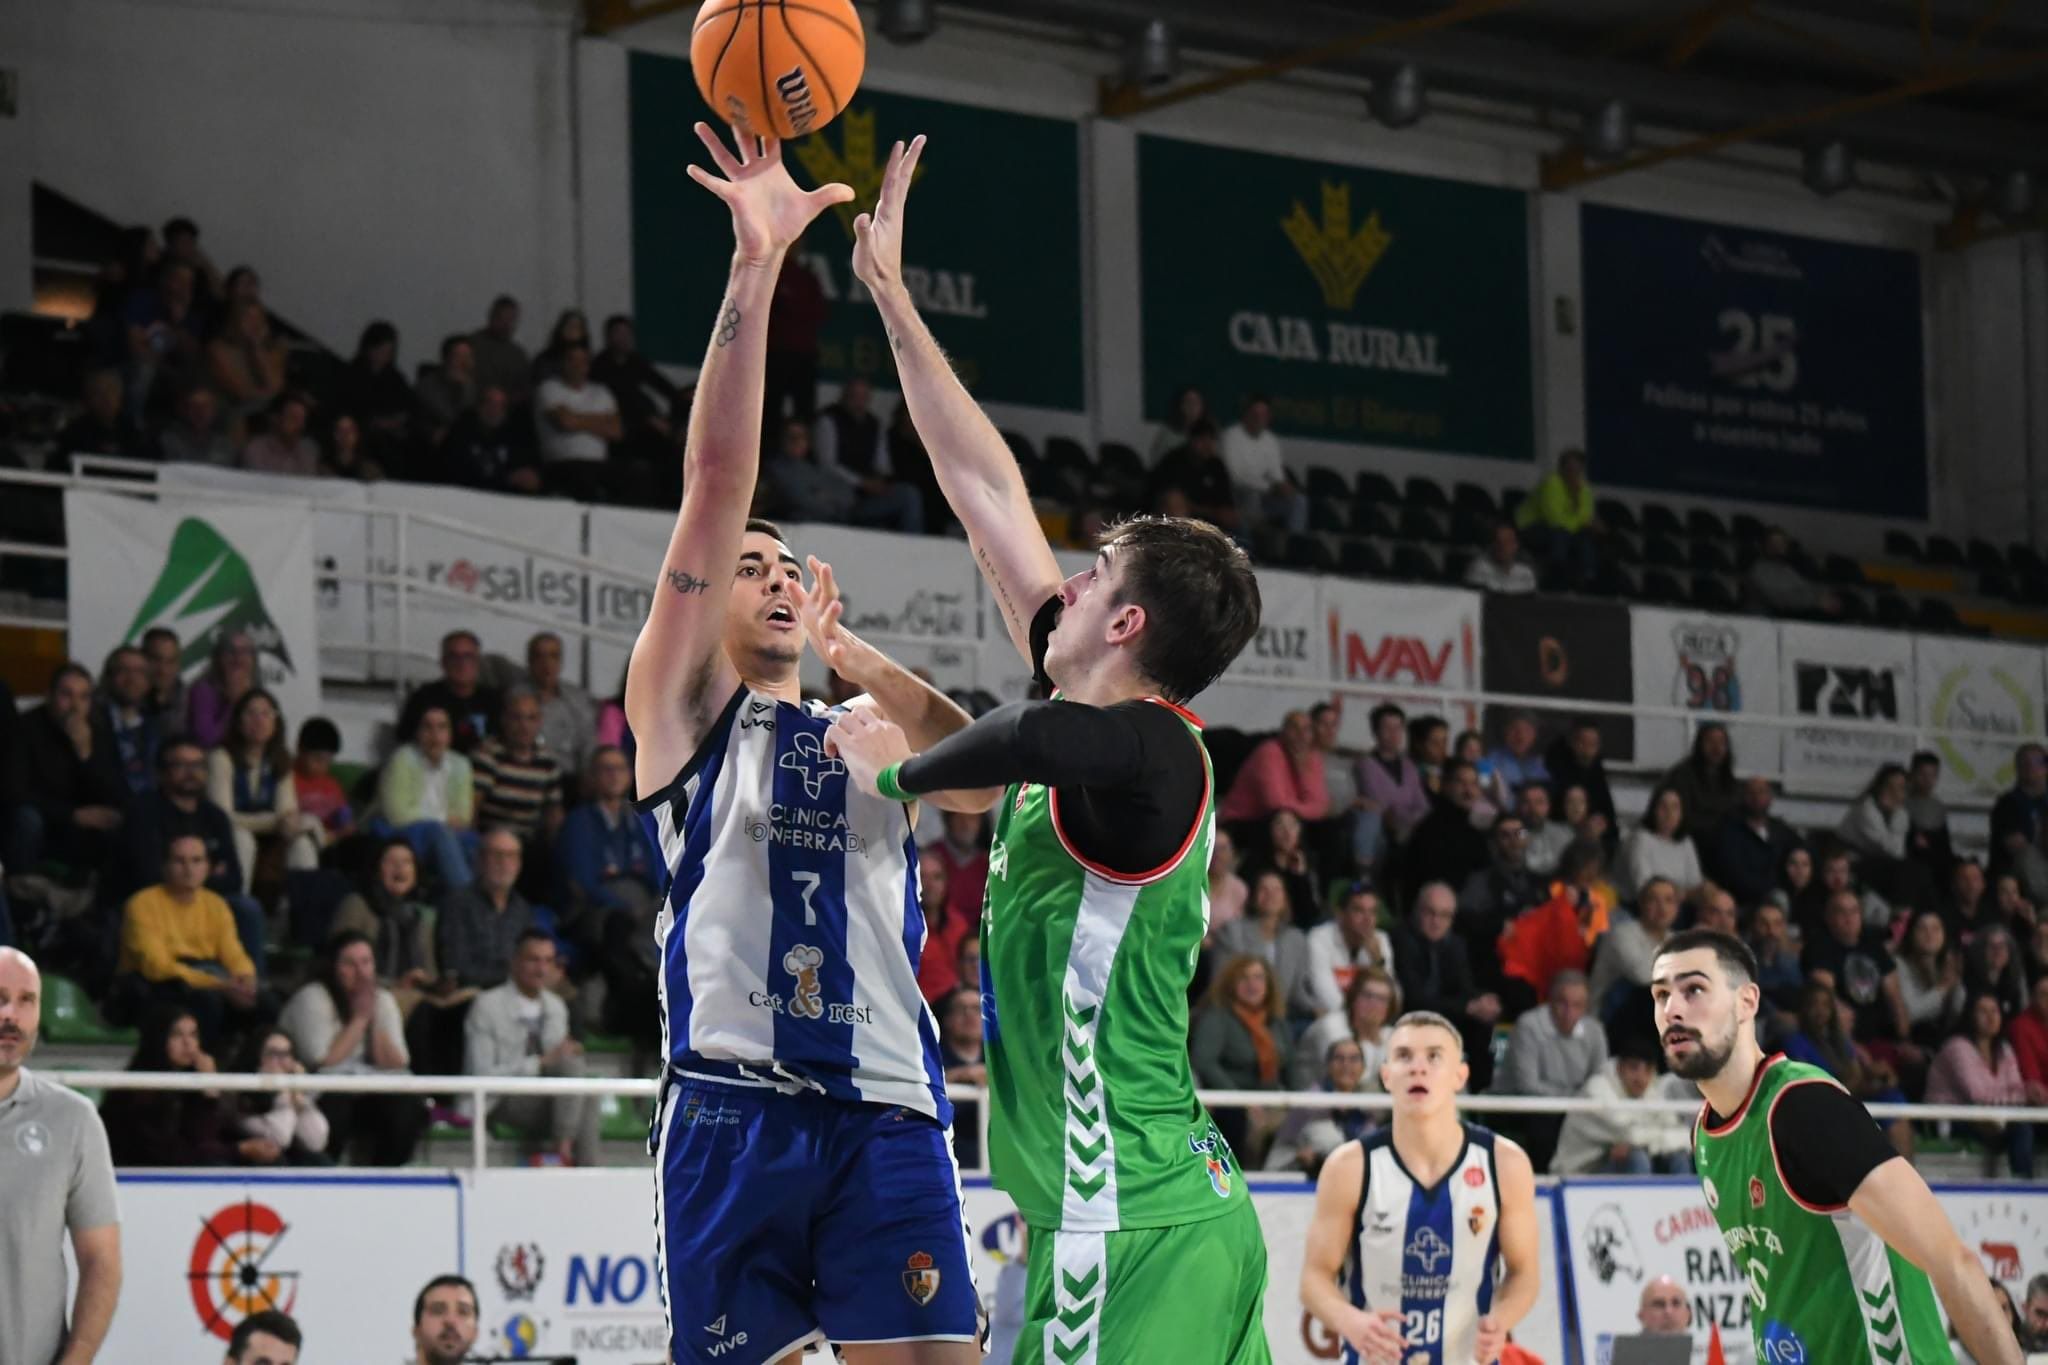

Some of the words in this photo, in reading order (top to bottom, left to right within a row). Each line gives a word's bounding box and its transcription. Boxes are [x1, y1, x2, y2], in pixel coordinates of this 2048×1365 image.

[1227, 309, 1320, 363] CAJA
[1326, 321, 1450, 378] RURAL
[1713, 306, 1800, 396] 25
[1346, 631, 1454, 687] MAV
[791, 872, 821, 926] 7
[828, 1001, 872, 1024] rest
[564, 1254, 662, 1307] NO
[706, 1331, 749, 1359] vive
[1406, 1309, 1441, 1346] 26
